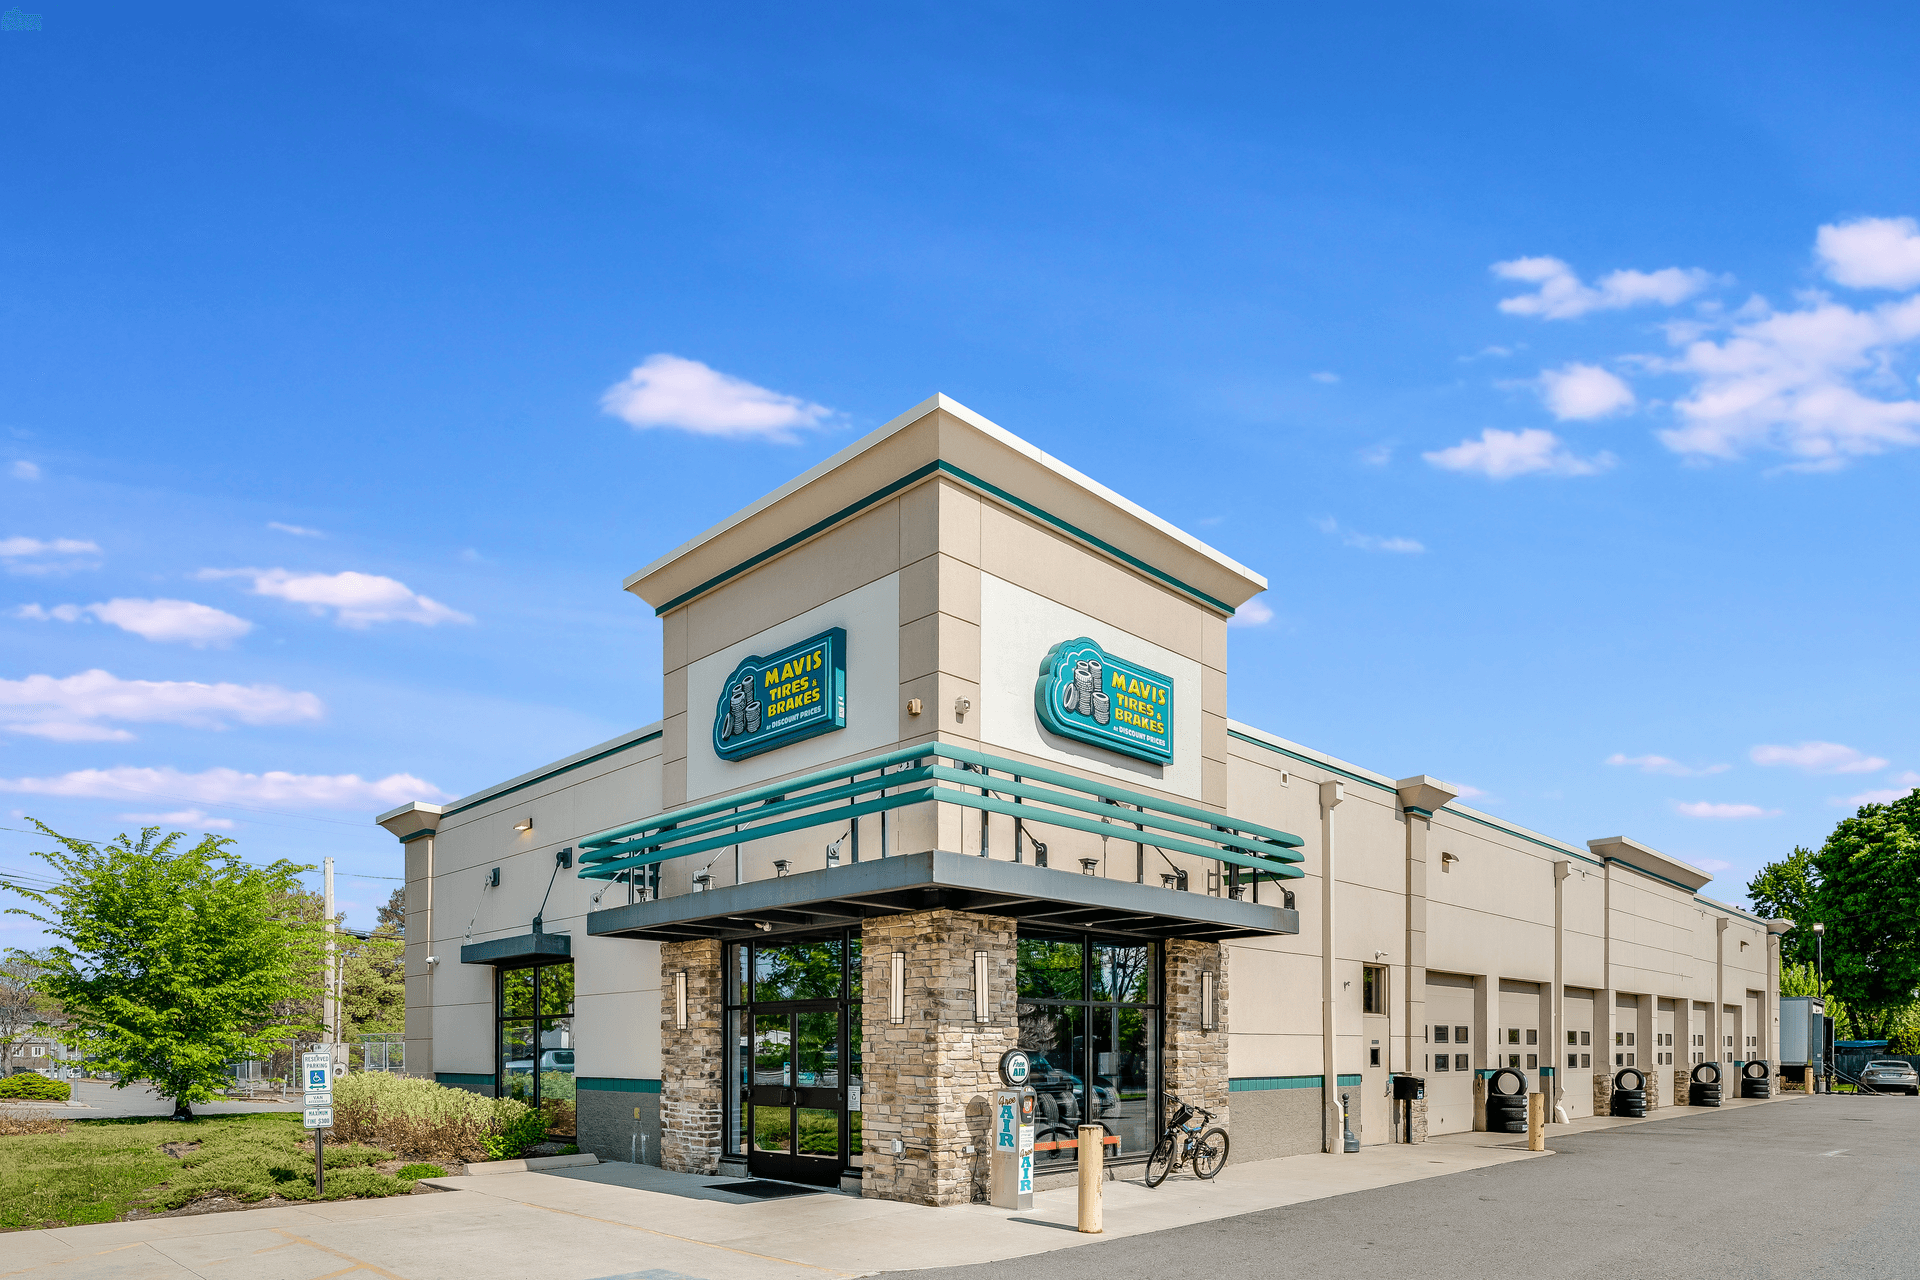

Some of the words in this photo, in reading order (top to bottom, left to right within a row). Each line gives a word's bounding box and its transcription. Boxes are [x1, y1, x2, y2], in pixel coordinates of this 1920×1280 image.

[764, 650, 822, 688] MAVIS
[770, 676, 809, 701] TIRES
[812, 678, 818, 687] &
[1112, 671, 1166, 706] MAVIS
[768, 688, 820, 718] BRAKES
[1116, 692, 1154, 717] TIRES
[1156, 712, 1162, 720] &
[772, 712, 800, 728] DISCOUNT
[800, 705, 822, 720] PRICES
[1115, 708, 1164, 734] BRAKES
[1119, 726, 1146, 740] DISCOUNT
[1146, 734, 1166, 746] PRICES
[1012, 1059, 1025, 1068] Free
[1012, 1068, 1026, 1076] AIR
[998, 1096, 1016, 1108] Free
[999, 1105, 1014, 1148] AIR
[1020, 1156, 1032, 1192] AIR
